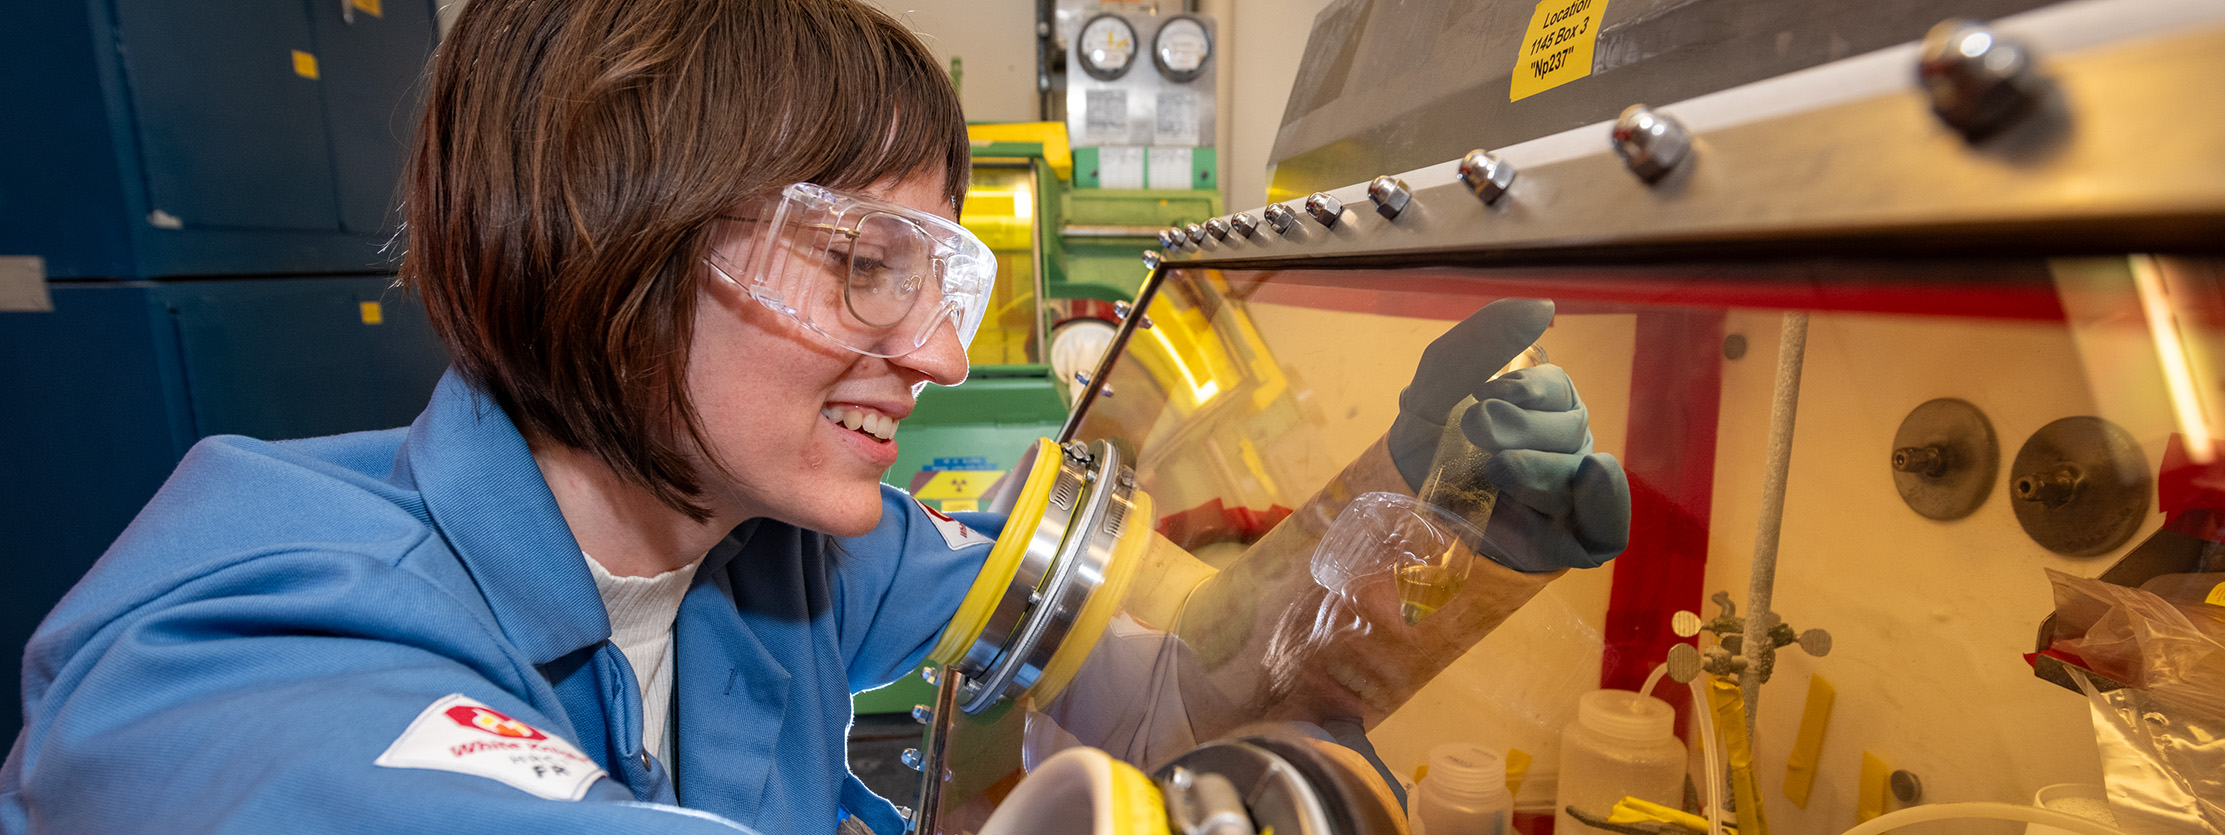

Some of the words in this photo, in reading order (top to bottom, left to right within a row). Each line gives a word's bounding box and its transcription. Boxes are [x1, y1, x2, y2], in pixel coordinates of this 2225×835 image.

[1543, 0, 1592, 29] Location
[1530, 31, 1556, 56] 1145
[1554, 24, 1579, 46] Box
[1579, 15, 1590, 35] 3
[1530, 45, 1575, 80] "Np237"
[450, 740, 520, 757] White
